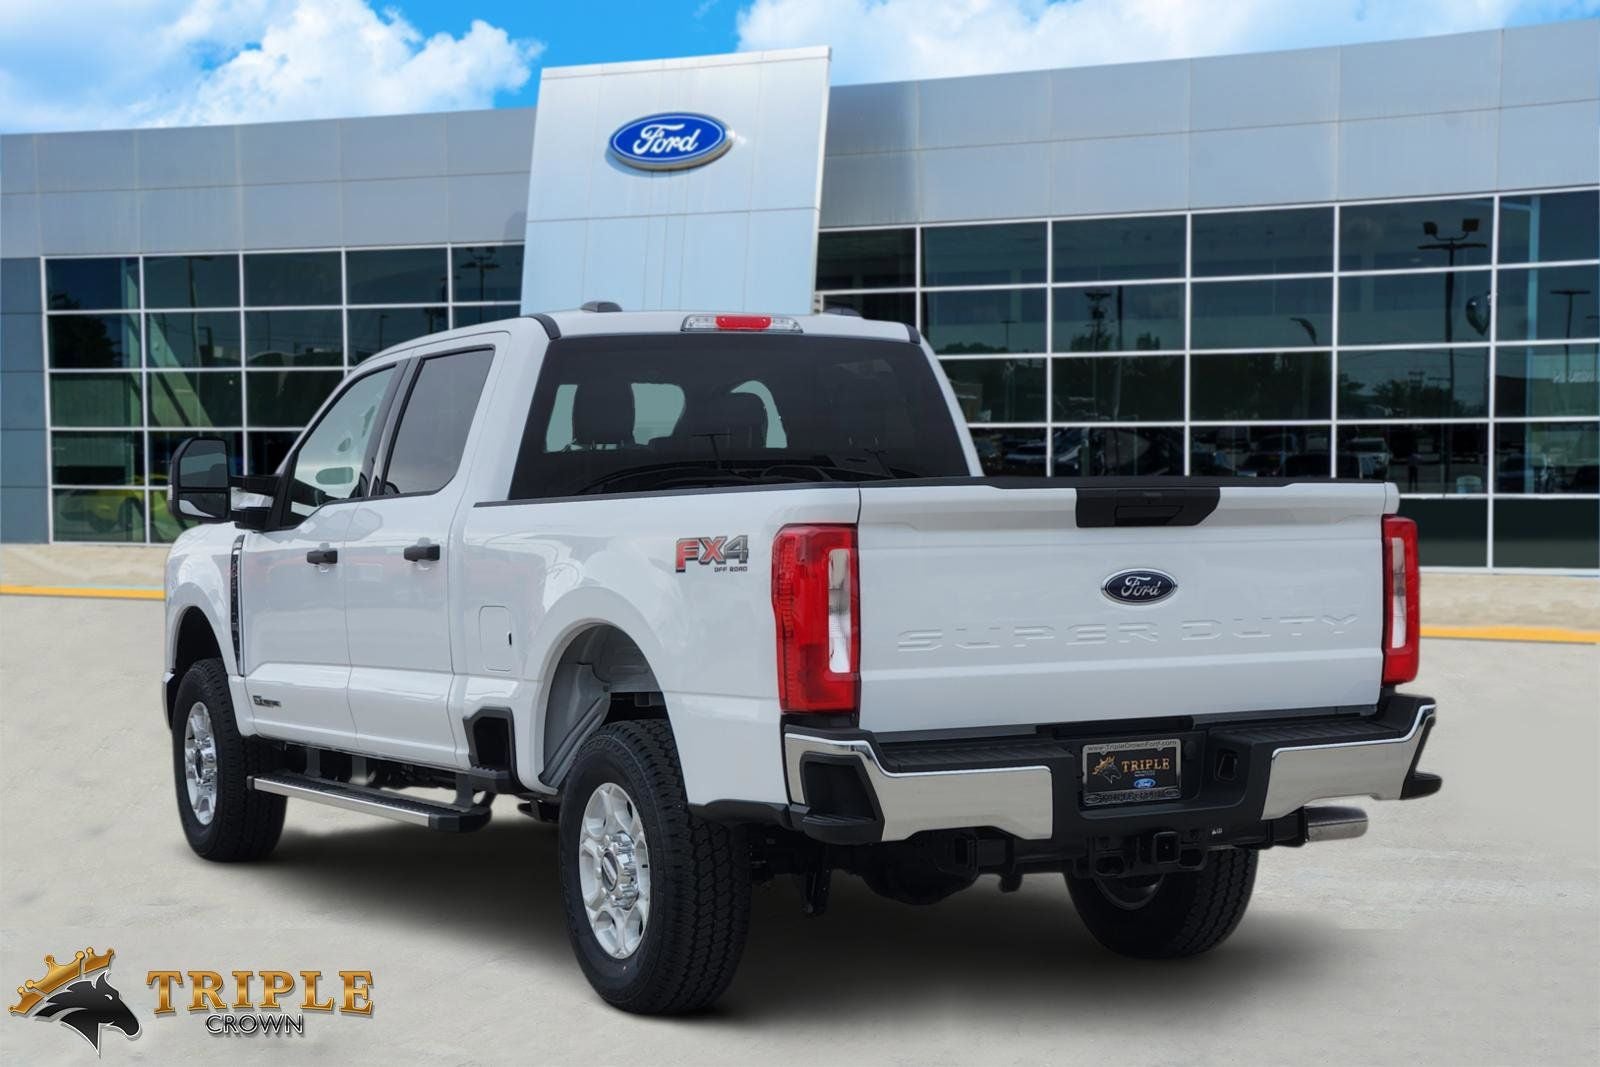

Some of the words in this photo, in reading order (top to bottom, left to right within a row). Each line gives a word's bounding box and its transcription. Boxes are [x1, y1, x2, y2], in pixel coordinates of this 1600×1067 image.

[632, 123, 702, 155] Ford
[675, 535, 749, 573] FX4
[729, 565, 748, 573] ROAD
[1121, 576, 1161, 597] Ford
[897, 622, 1159, 652] SUPER
[1181, 613, 1358, 641] DUTY
[1121, 758, 1170, 773] TRIPLE
